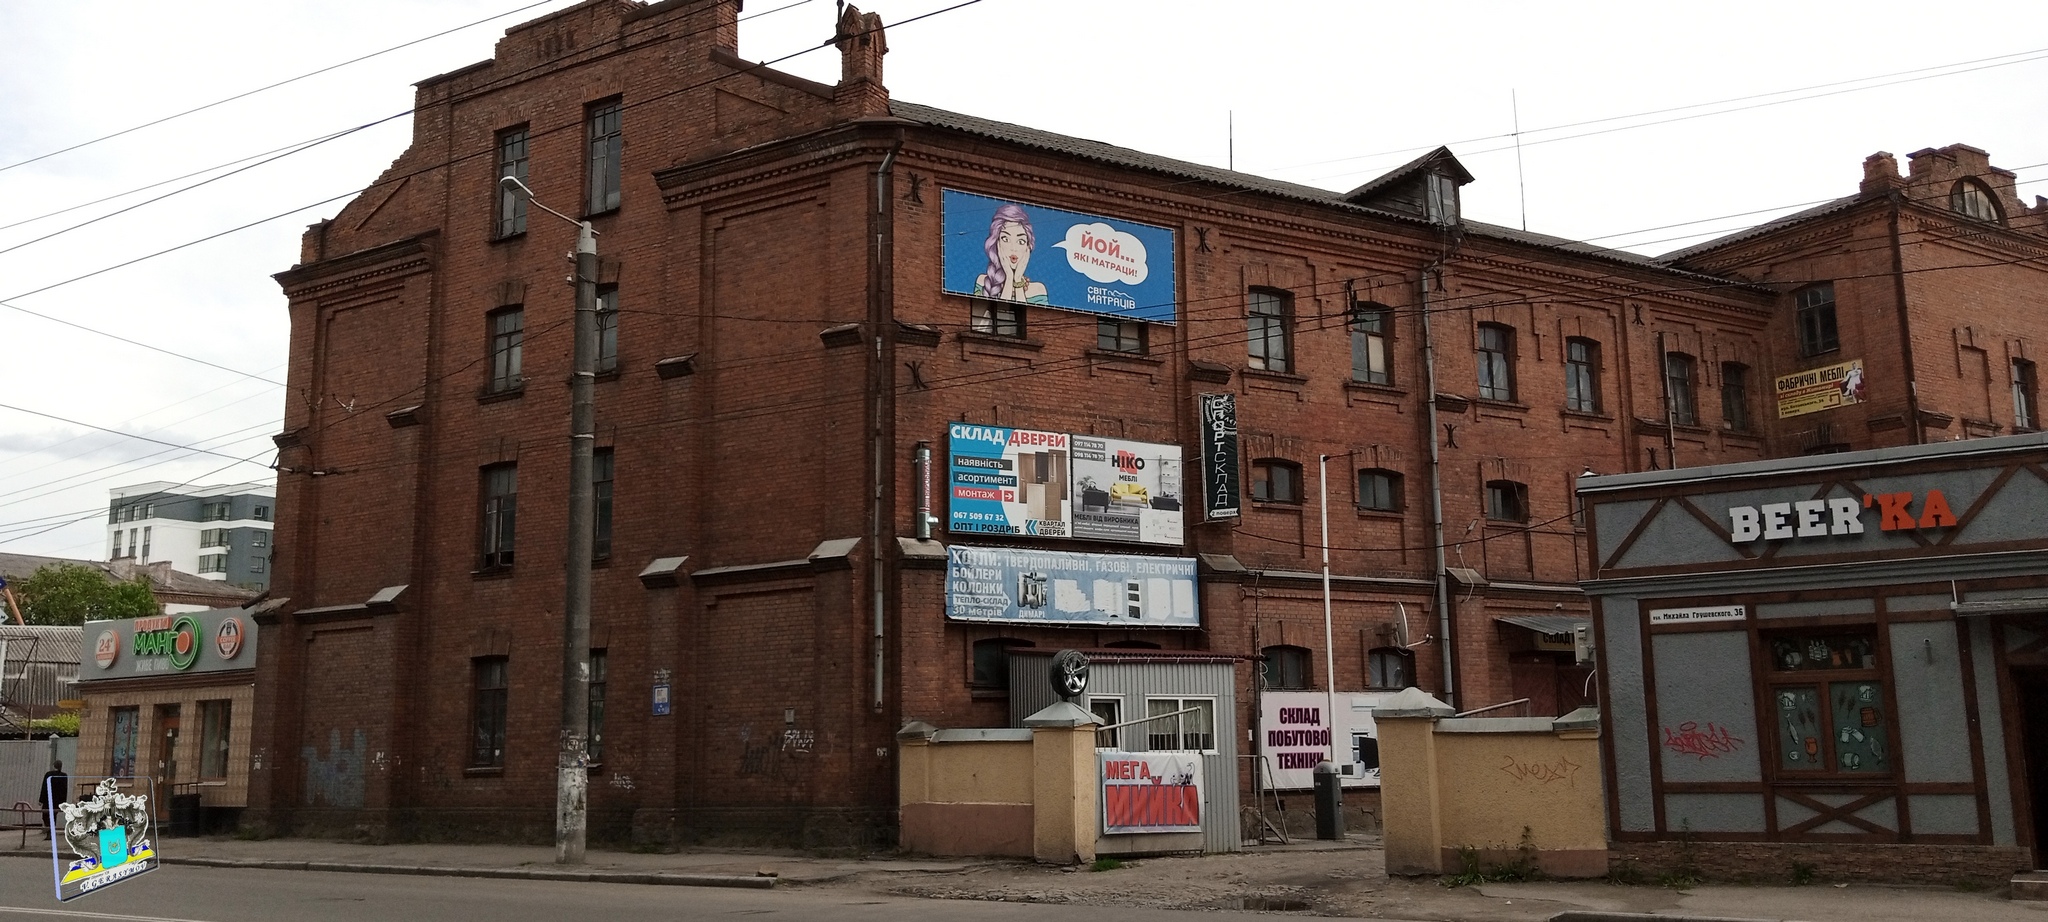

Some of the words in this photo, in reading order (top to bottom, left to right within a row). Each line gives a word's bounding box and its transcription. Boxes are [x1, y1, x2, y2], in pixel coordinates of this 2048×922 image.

[1081, 231, 1135, 263] ЙОЙ...
[1074, 252, 1089, 263] ЯКІ
[1091, 256, 1138, 277] МАТРАЦИ!
[1087, 286, 1108, 296] СВІТ
[1087, 294, 1136, 309] МАТРАЦІВ
[1778, 372, 1817, 391] ФАБРИЧНІ
[1820, 366, 1845, 383] МЕБЛІ
[951, 425, 1005, 446] СКЛАД
[957, 458, 1004, 469] наявність
[1111, 454, 1145, 470] НІКО
[957, 473, 1014, 485] асортимент
[1118, 474, 1138, 482] МЕБЛІ
[958, 489, 996, 499] монтаж
[953, 511, 967, 519] 067
[969, 512, 983, 520] 509
[984, 513, 993, 521] 67
[995, 513, 1005, 521] 32
[1074, 513, 1092, 521] МЕБЛІ
[1093, 515, 1103, 523] ВІД
[1104, 516, 1139, 524] ВИРОБНИКА
[1728, 489, 1957, 543] BEER'KA
[953, 522, 974, 531] ОПТ
[981, 524, 1021, 534] РОЗДРІБ
[1039, 520, 1066, 528] КВАРТАЛ
[1039, 527, 1066, 536] ДВЕРЕЙ
[952, 550, 1001, 567] КОТЛИ:
[1005, 555, 1092, 573] ТВЕРДОПАЛИВНІ,
[1095, 561, 1133, 574] ГАЗОВІ,
[1136, 563, 1194, 576] ЕЛЕКТРИЧНІ
[952, 566, 1002, 580] БОЙЛЕРИ
[952, 580, 1004, 594] КОЛОНКИ
[955, 595, 1009, 606] ТЕПЛО-СКЛАД
[953, 604, 965, 614] 30
[968, 607, 1003, 618] метрів
[1018, 609, 1045, 619] ДИМАРІ
[1663, 612, 1690, 620] Михайла
[1734, 607, 1744, 616] 36
[1543, 631, 1571, 645] СКЛАД
[135, 658, 152, 672] ЖИВЕ
[1279, 707, 1320, 726] СКЛАД
[1105, 760, 1151, 780] МЕГА
[1105, 775, 1199, 826] МИЙКА
